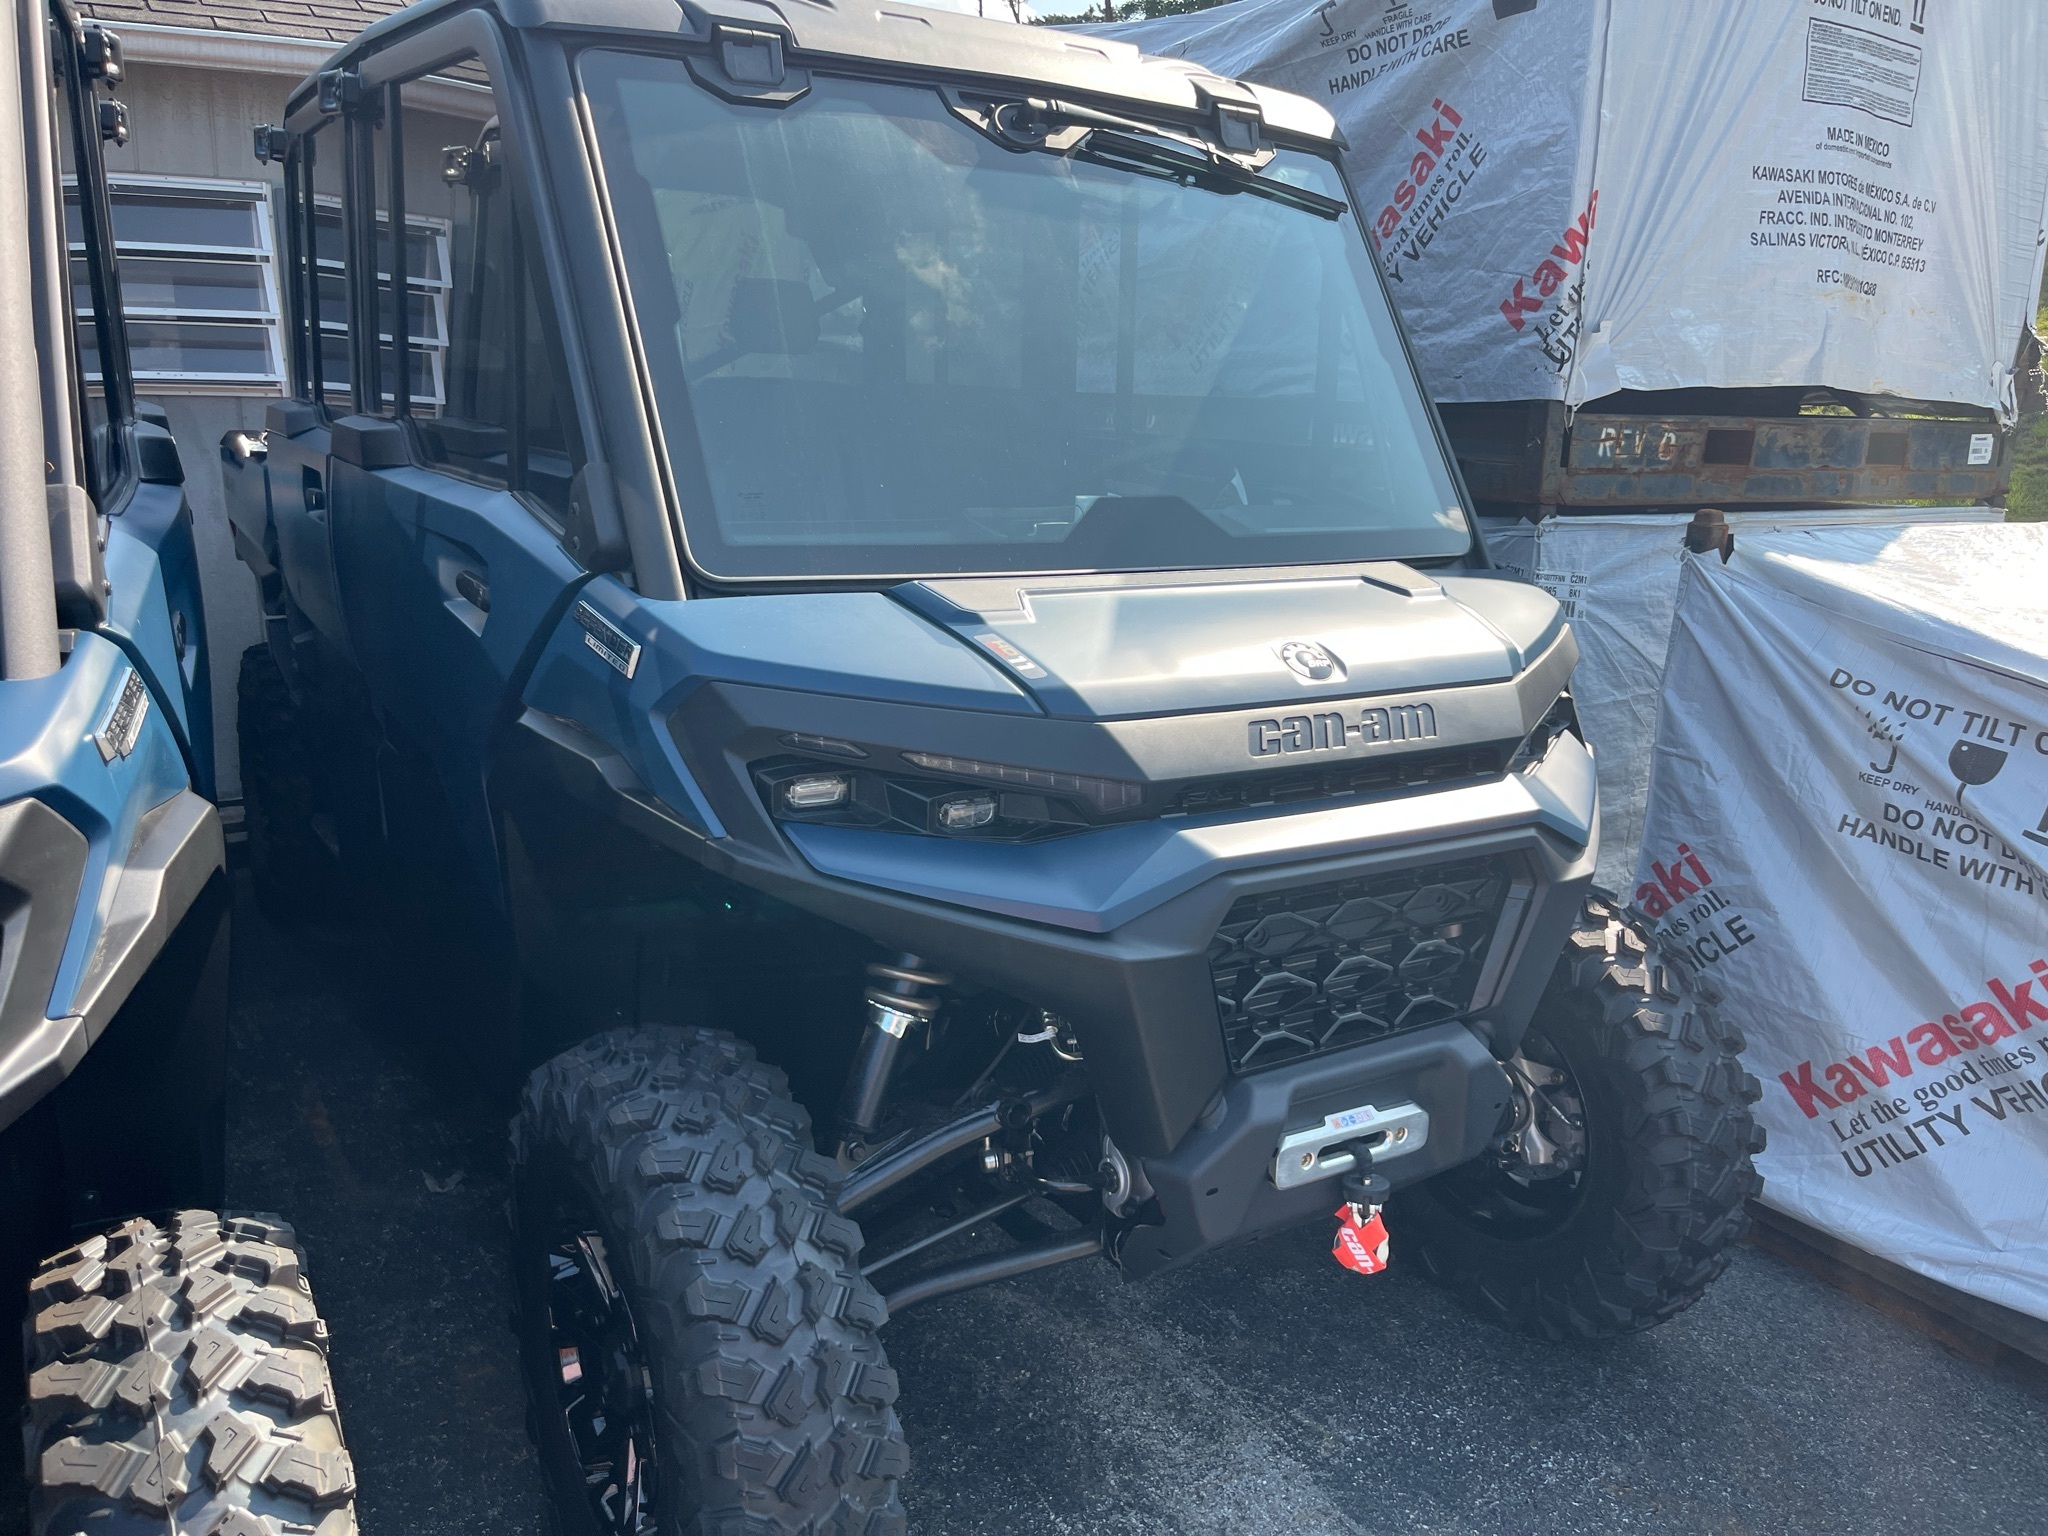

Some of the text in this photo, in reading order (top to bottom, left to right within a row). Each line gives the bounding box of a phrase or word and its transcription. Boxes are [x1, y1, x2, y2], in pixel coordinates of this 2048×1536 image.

[1382, 8, 1413, 25] FRAGILE
[1395, 20, 1413, 32] WITH
[1414, 12, 1433, 26] CARE
[1869, 1, 1882, 20] ON
[1882, 5, 1902, 27] END.
[1320, 29, 1358, 49] KEEP DRY
[1347, 16, 1452, 65] DO NOT DROP
[1328, 64, 1388, 96] HANDLE
[1421, 29, 1471, 58] CARE
[1815, 142, 1822, 150] of
[1827, 127, 1889, 157] MADE IN MEXICO
[1410, 174, 1445, 227] times
[1444, 132, 1473, 172] roll.
[1752, 165, 1814, 183] KAWASAKI
[1895, 191, 1910, 207] S.A.
[1912, 197, 1922, 210] de
[1777, 190, 1831, 206] AVENIDA
[1402, 142, 1488, 262] VEHICLE
[1750, 232, 1806, 247] SALINAS
[1860, 243, 1887, 264] ÉXICO
[1759, 210, 1807, 225] FRACC.
[1810, 212, 1832, 227] IND.
[1874, 228, 1924, 252] MONTERREY
[1570, 574, 1587, 585] C2M1
[574, 604, 634, 661] DEFENDER
[1829, 667, 1876, 696] DO
[1882, 690, 1955, 726] NOT
[1962, 710, 2027, 747] TILT
[1247, 702, 1437, 759] can-am
[1858, 771, 1920, 796] KEEP DRY
[1883, 802, 1924, 830] DO
[1931, 816, 1994, 850] NOT
[1924, 799, 1973, 820] HANDLE
[1837, 814, 2034, 895] HANDLE WITH
[1688, 889, 1731, 925] roll.
[1827, 1109, 1872, 1143] Let
[1870, 1097, 1911, 1125] the
[1913, 1060, 1984, 1112] good
[1978, 1044, 2037, 1078] times
[1841, 1104, 1971, 1178] UTILITY
